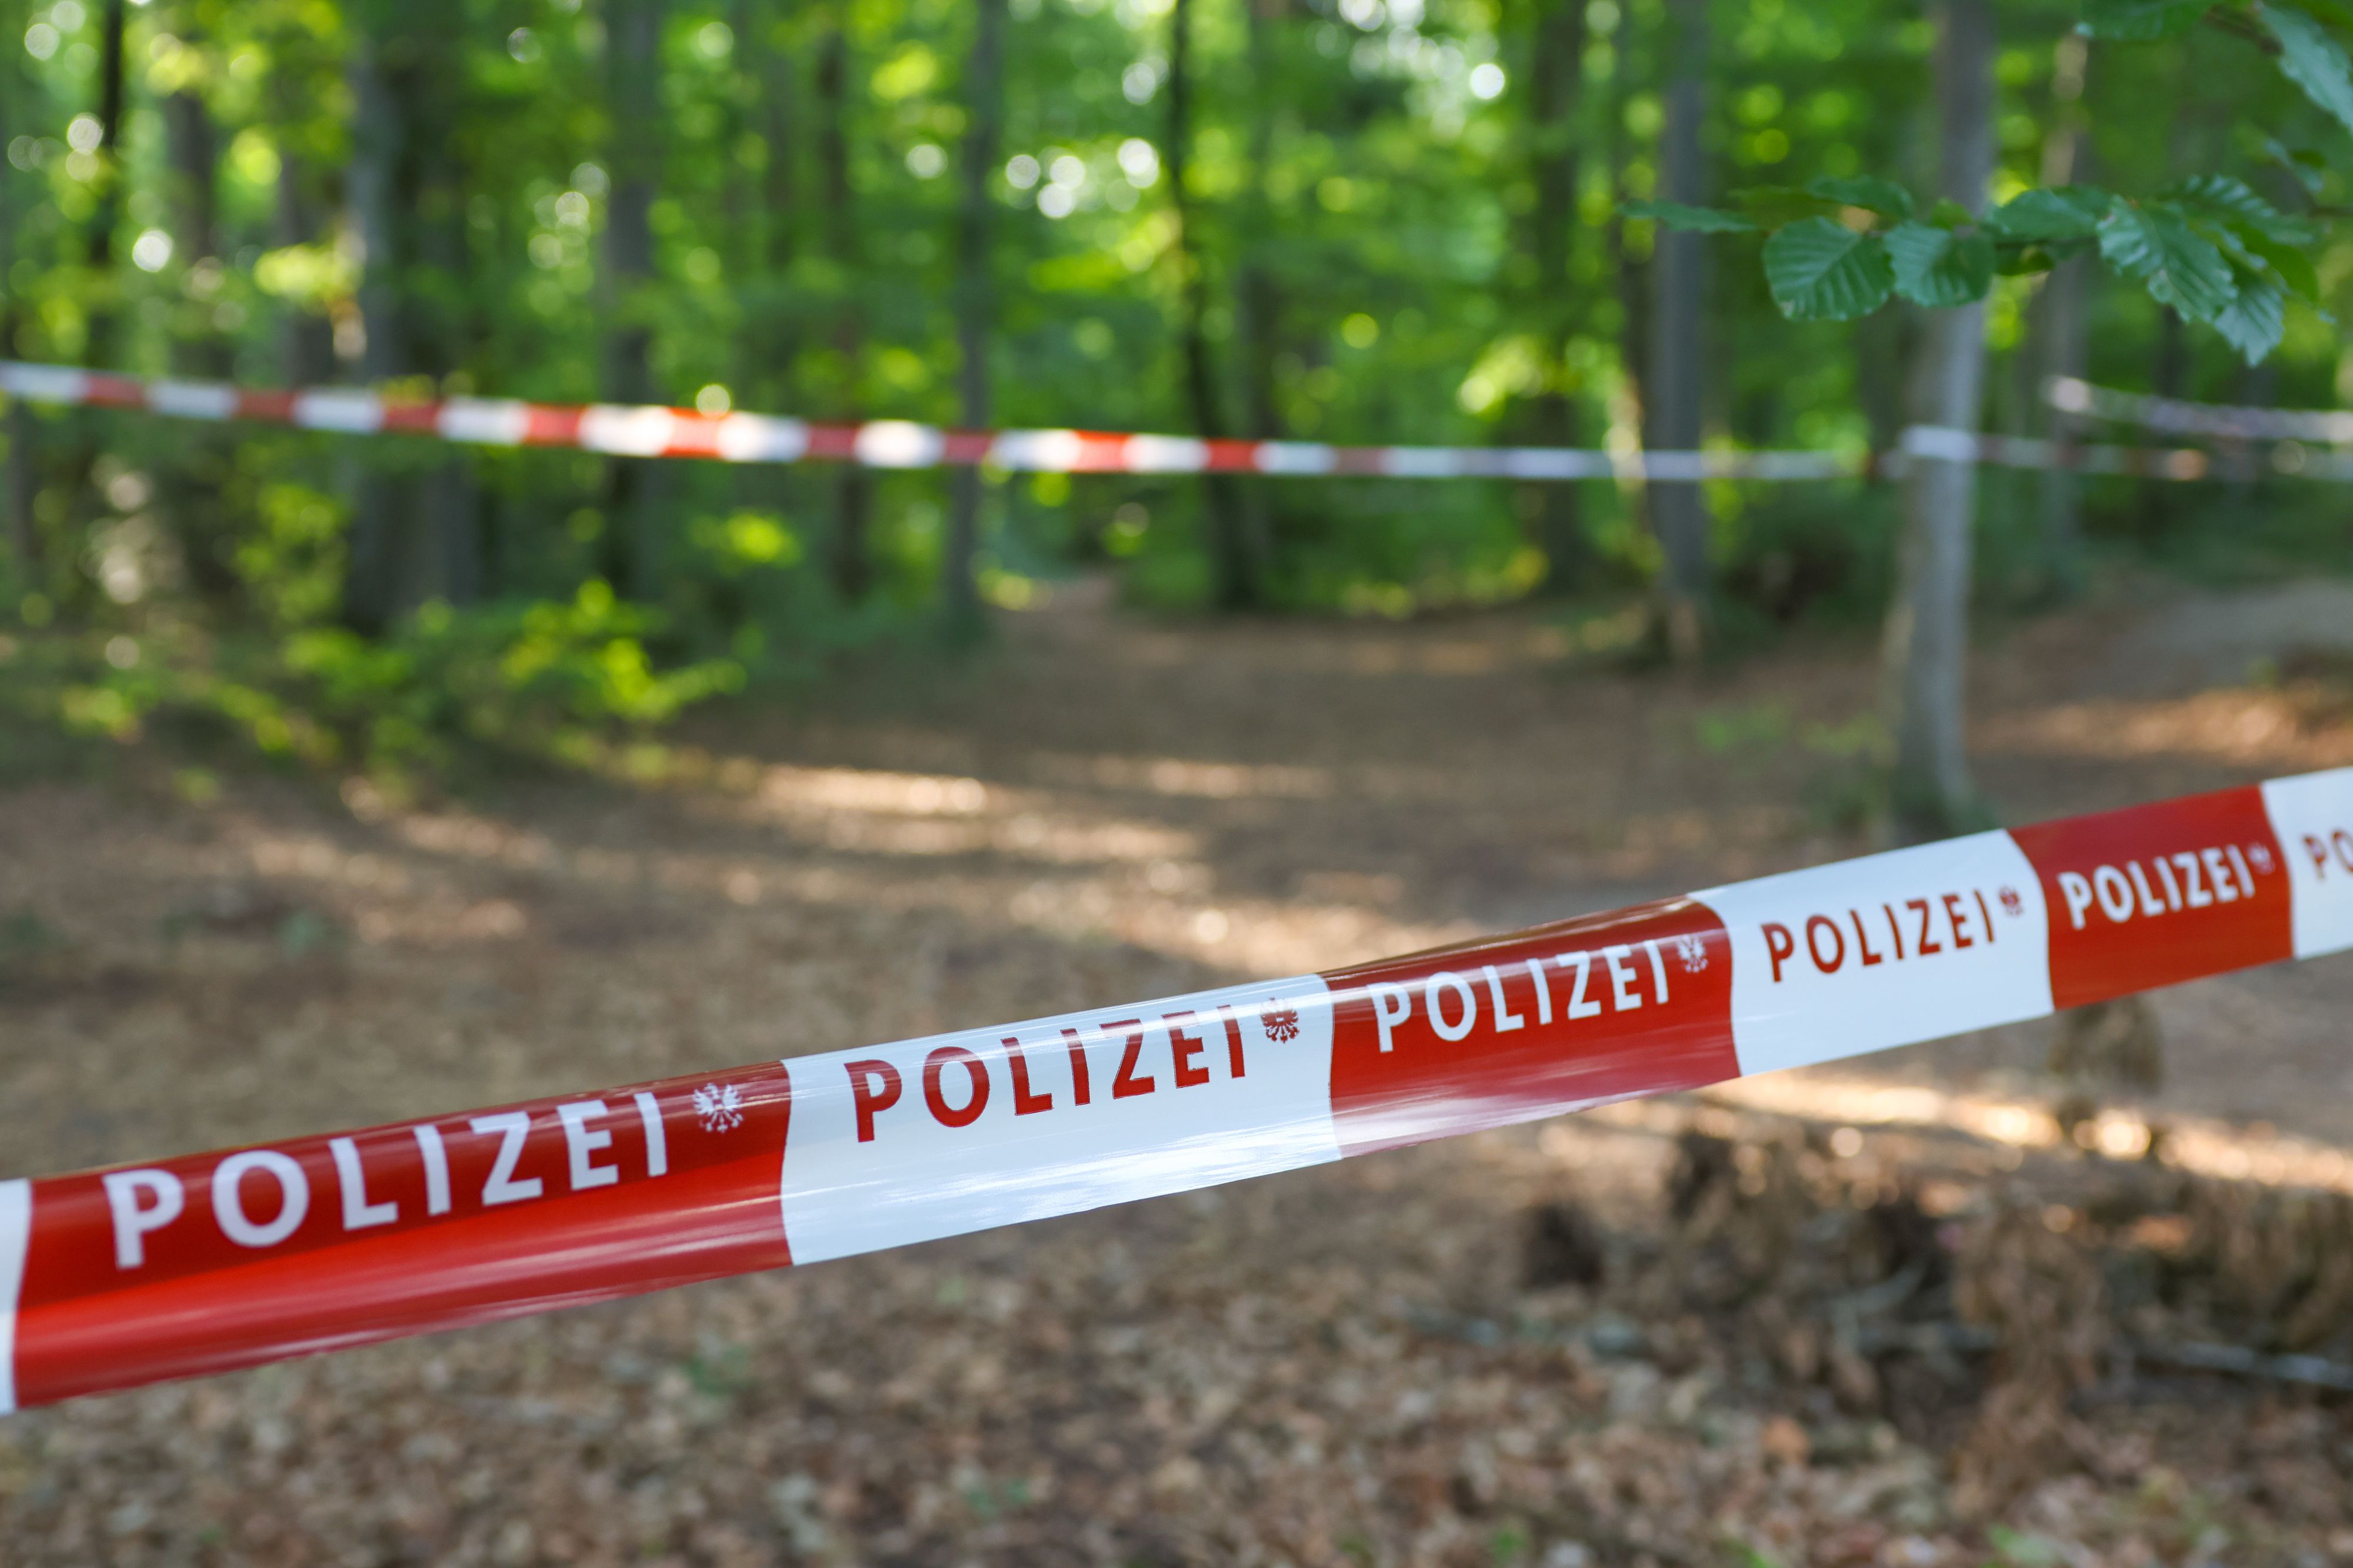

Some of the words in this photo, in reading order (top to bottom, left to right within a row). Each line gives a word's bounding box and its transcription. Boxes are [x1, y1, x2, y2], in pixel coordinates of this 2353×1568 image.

[103, 1092, 667, 1269] POLIZEI
[845, 1003, 1245, 1143] POLIZEI
[1366, 940, 1669, 1053] POLIZEI
[1761, 889, 1994, 983] POLIZEI
[2057, 844, 2255, 930] POLIZEI
